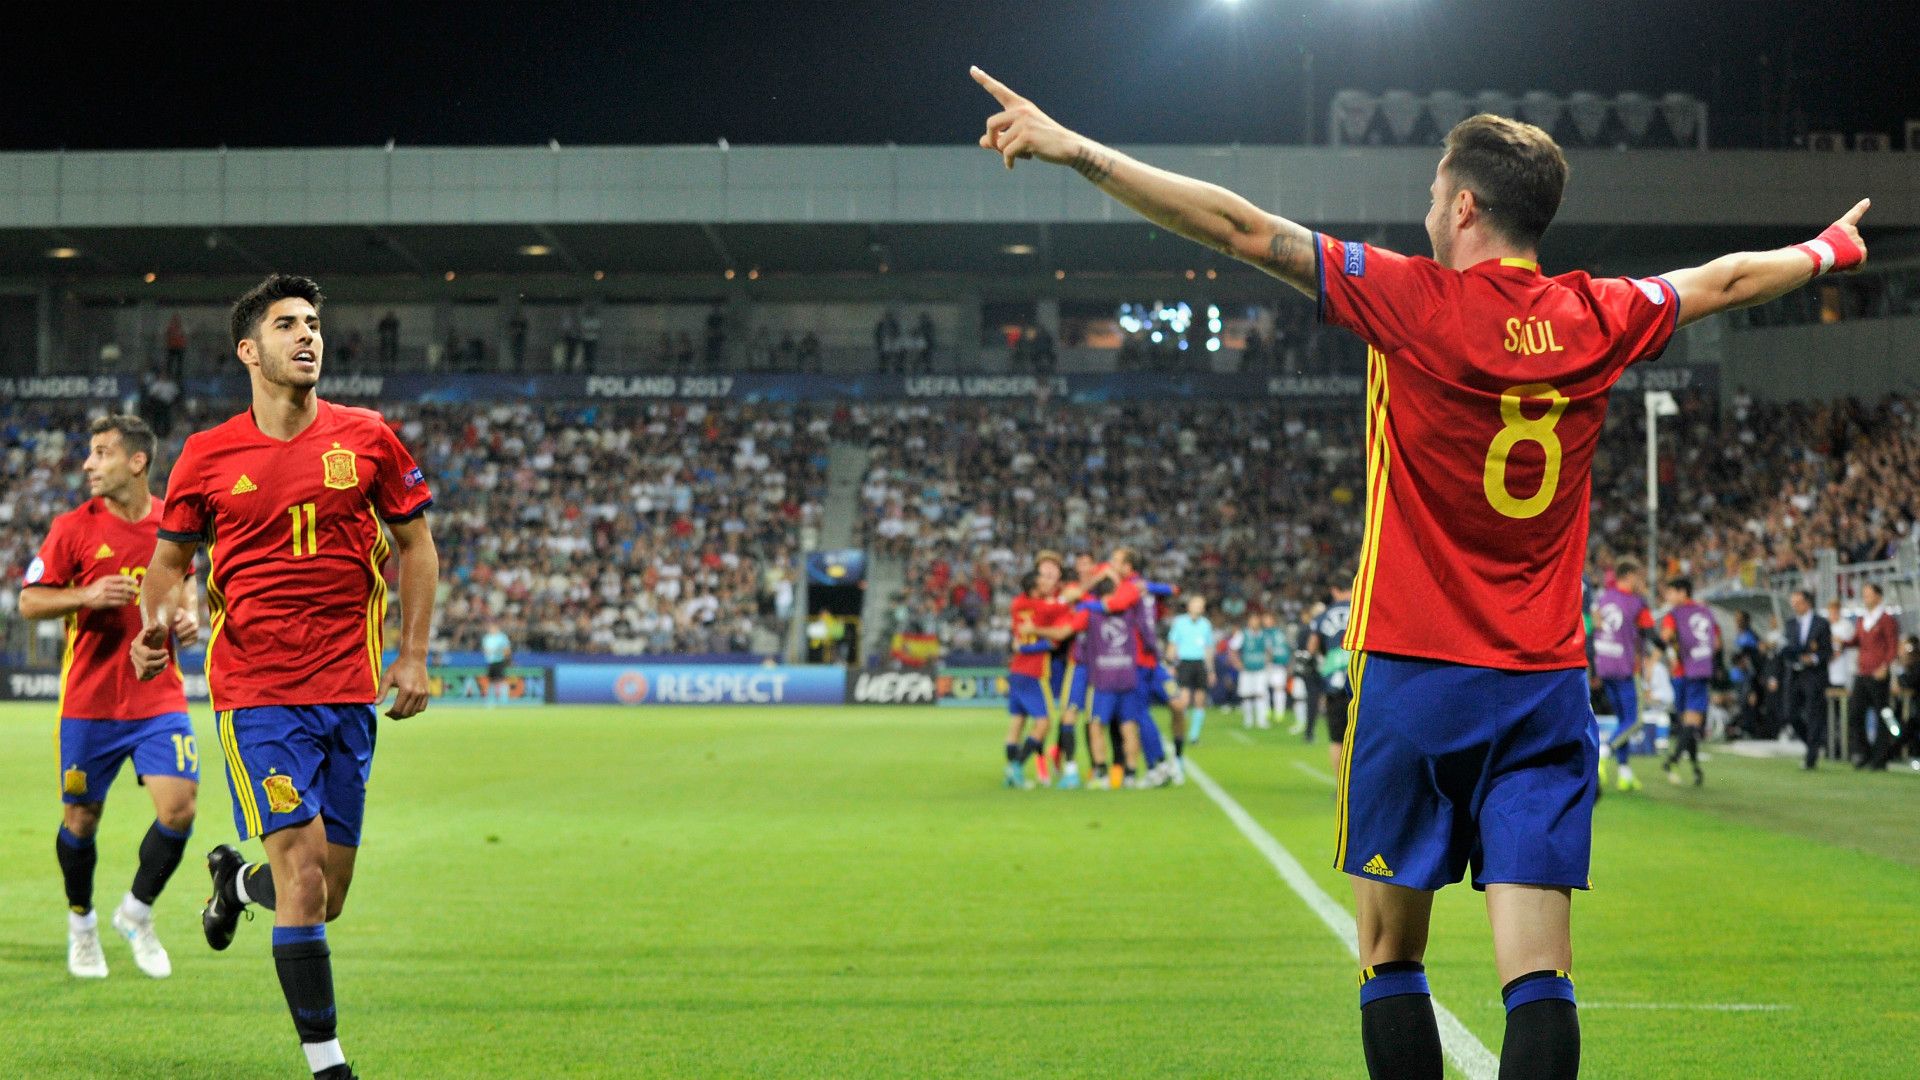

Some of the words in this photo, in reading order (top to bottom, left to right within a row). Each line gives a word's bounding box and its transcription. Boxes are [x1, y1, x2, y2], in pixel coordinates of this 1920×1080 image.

[1504, 316, 1564, 356] SAÚL
[19, 376, 119, 398] UNDER-21
[586, 376, 677, 397] POLAND
[681, 376, 734, 397] 2017
[905, 376, 962, 397] UEFA
[1267, 374, 1362, 396] KRAKÓW
[1643, 368, 1690, 389] 2017
[1483, 383, 1570, 519] 8
[288, 503, 317, 557] 11
[656, 672, 788, 702] RESPECT
[855, 672, 933, 702] UEFA
[171, 734, 198, 773] 19
[1362, 865, 1394, 877] adidas
